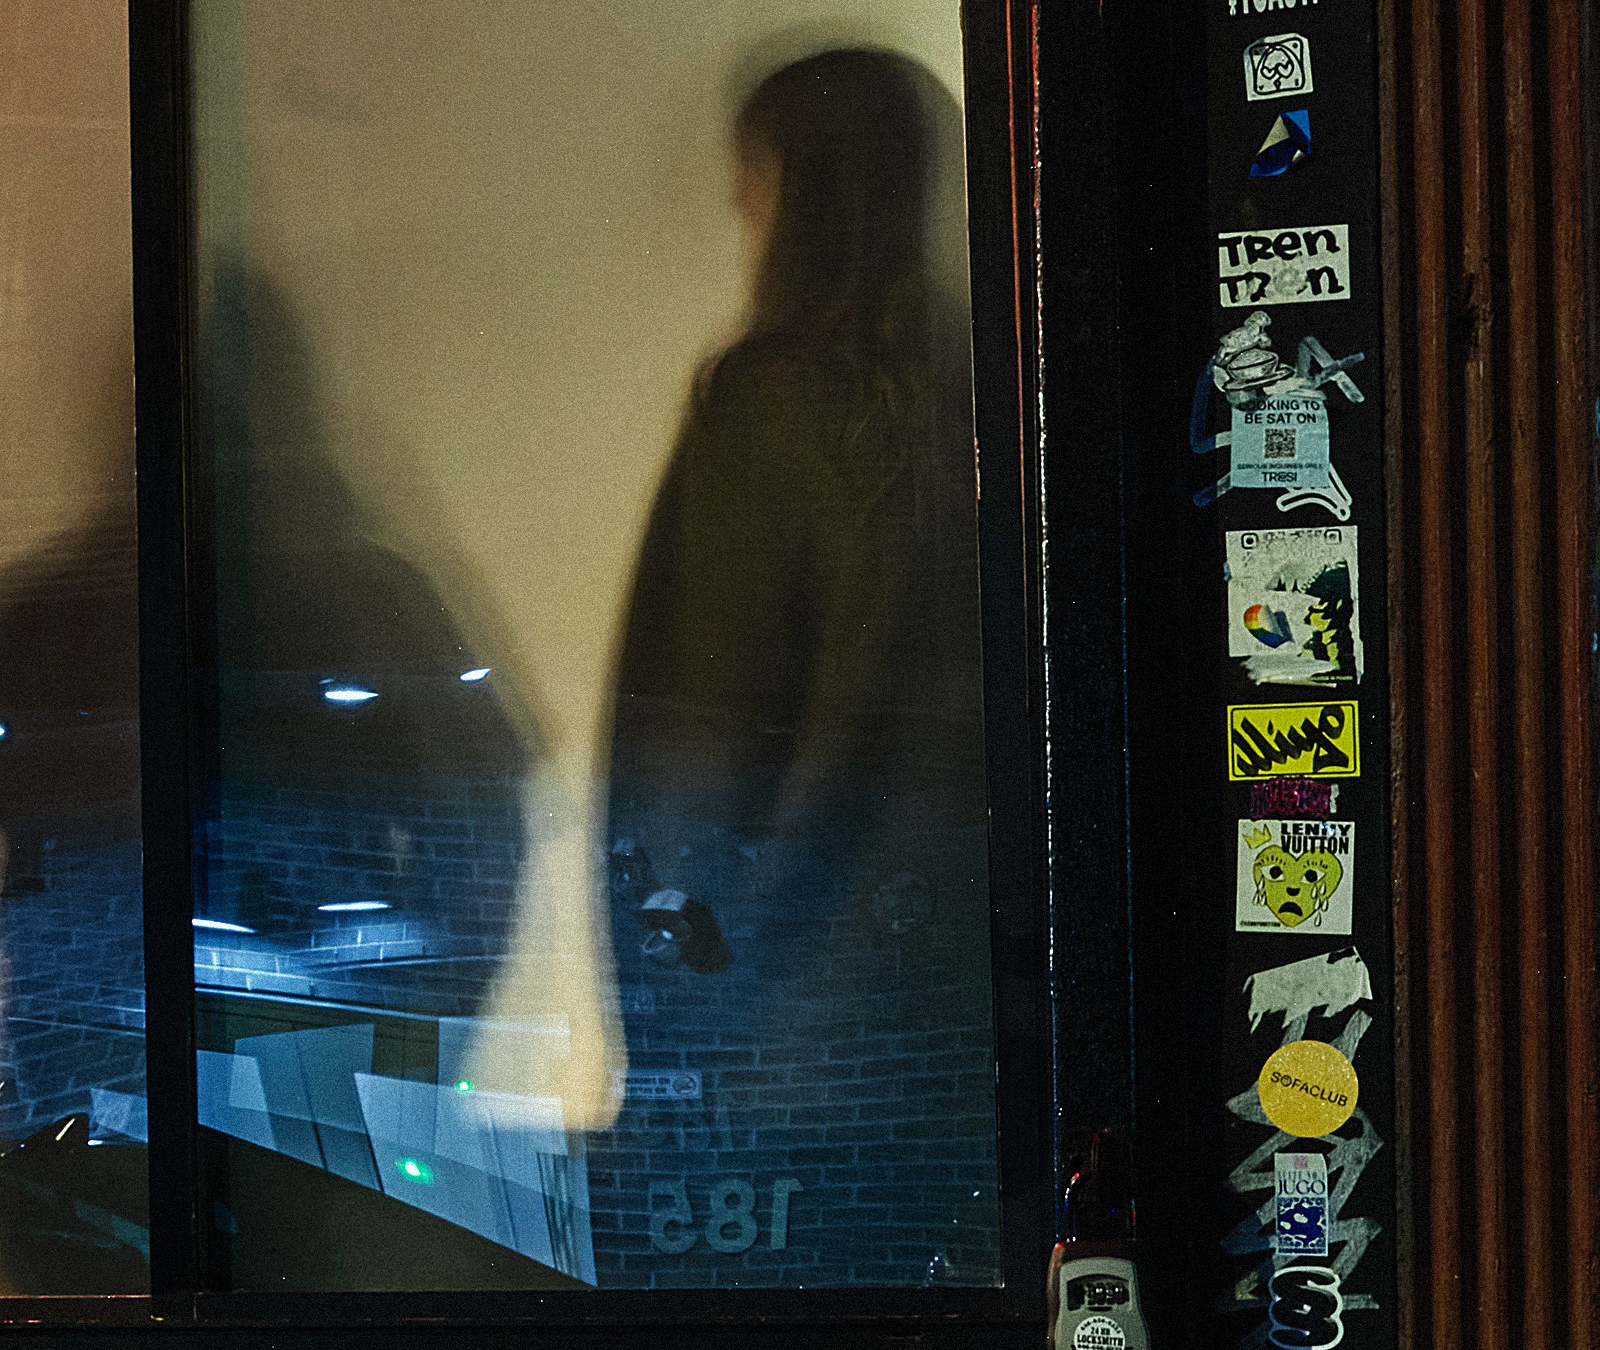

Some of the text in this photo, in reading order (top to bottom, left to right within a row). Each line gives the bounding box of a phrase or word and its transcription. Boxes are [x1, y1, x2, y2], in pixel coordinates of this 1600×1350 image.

[1241, 399, 1320, 411] OOKING TO
[1244, 412, 1316, 424] BE SAT ON
[1281, 836, 1350, 854] VUITTON
[1270, 1071, 1348, 1107] SOFACLUB
[1277, 1179, 1326, 1195] JUGO
[1077, 1334, 1124, 1346] LOCKSMITH
